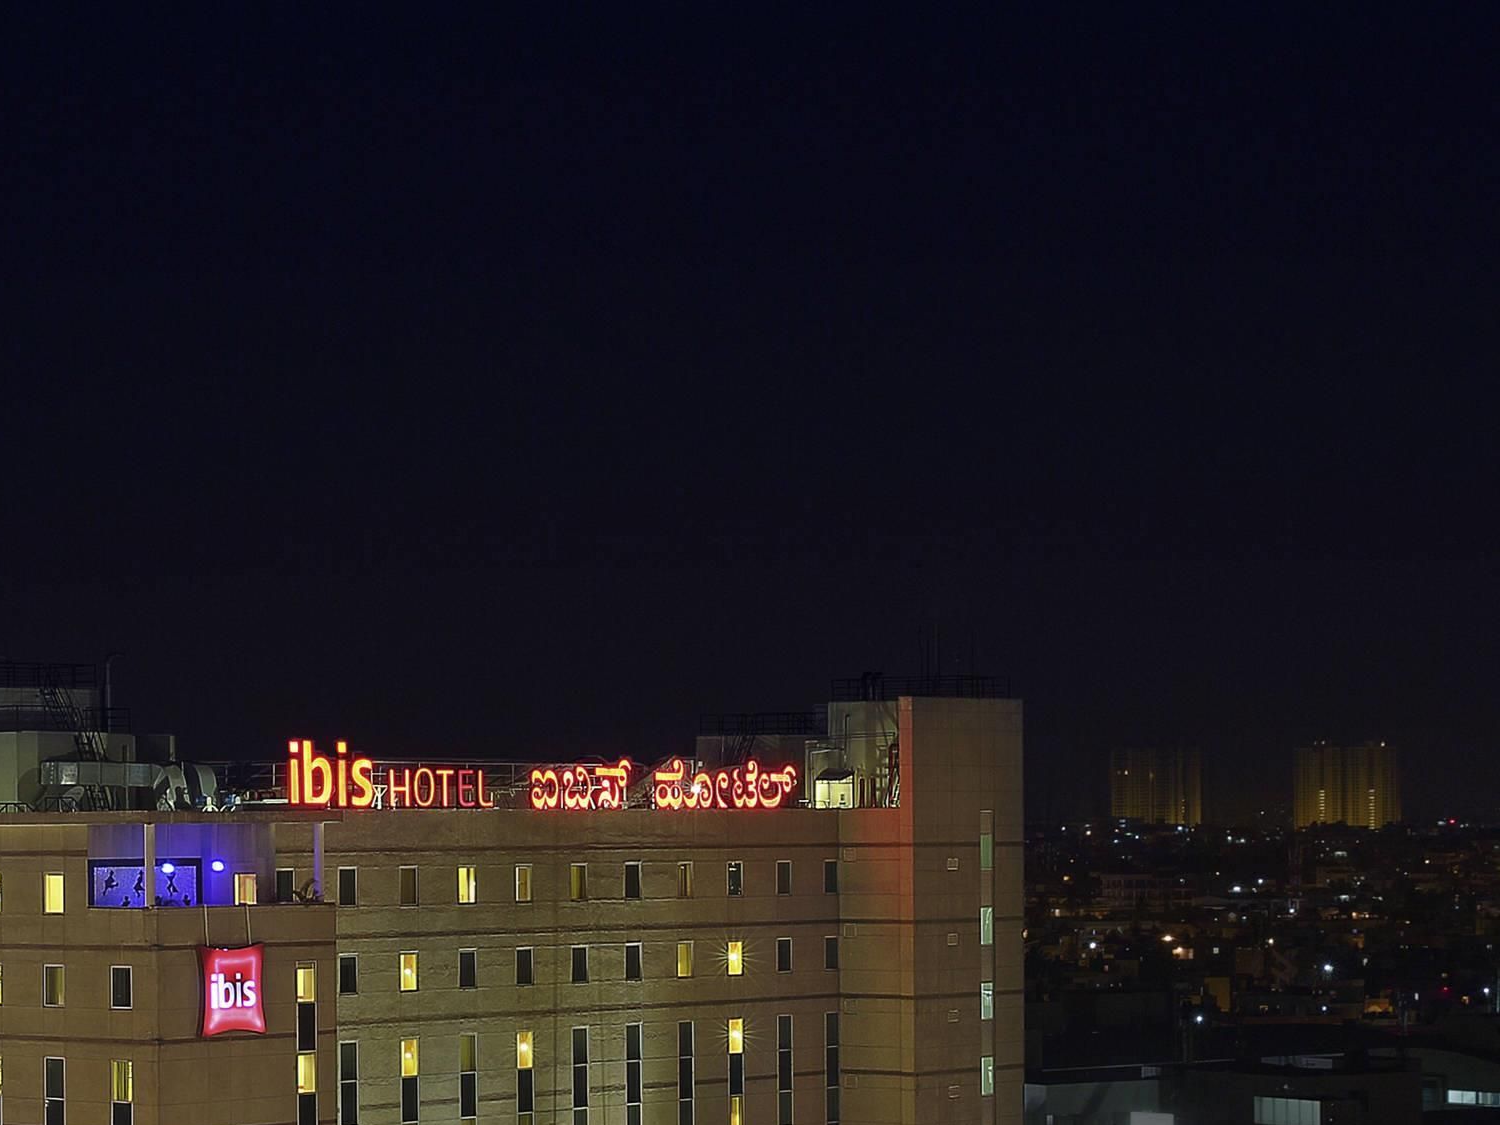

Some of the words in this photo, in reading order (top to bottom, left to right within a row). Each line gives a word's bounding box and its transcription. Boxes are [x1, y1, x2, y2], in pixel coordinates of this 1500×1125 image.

[288, 740, 374, 808] ibis
[388, 767, 494, 808] HOTEL
[210, 972, 257, 1009] ibis
